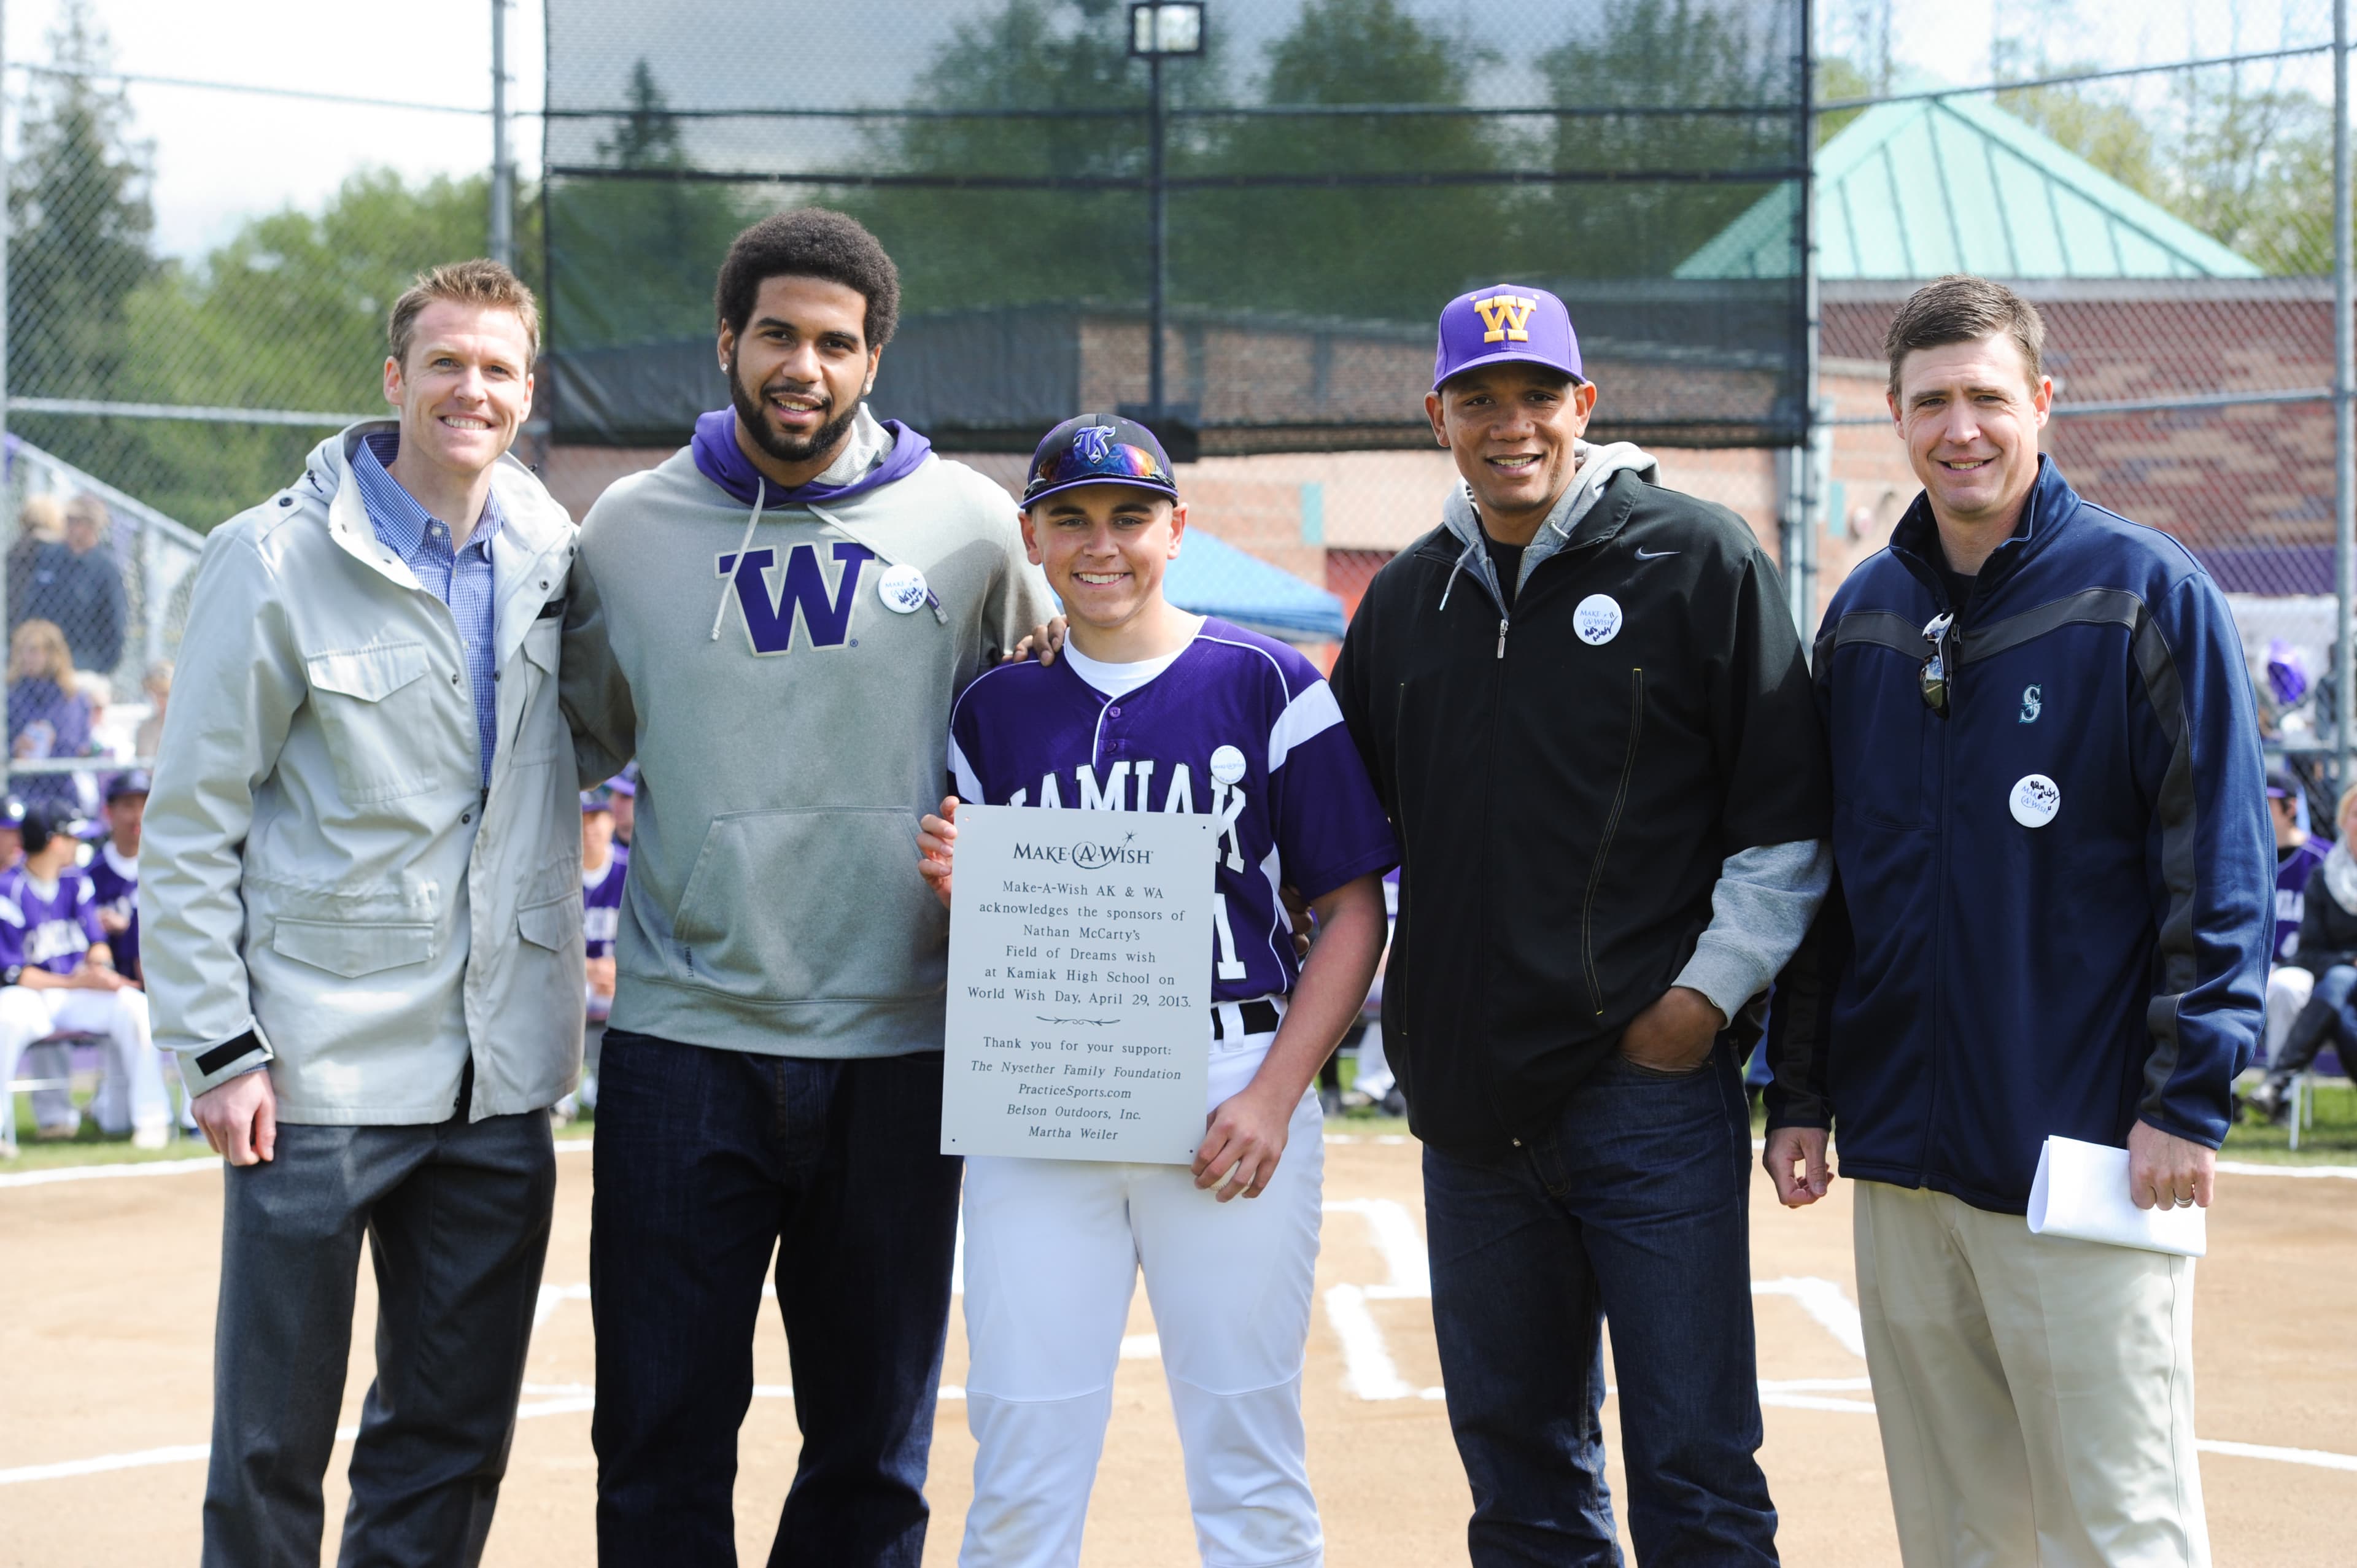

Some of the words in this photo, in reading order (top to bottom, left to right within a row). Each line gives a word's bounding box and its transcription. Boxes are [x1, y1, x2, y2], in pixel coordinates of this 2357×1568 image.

[1474, 295, 1537, 344] W
[1073, 425, 1116, 465] K
[714, 540, 879, 657] W
[1008, 760, 1247, 874] MIAK
[1003, 880, 1088, 895] Make-A-Wish
[1096, 885, 1116, 897] AK
[1124, 886, 1135, 898] &
[1144, 887, 1164, 899] WA
[979, 902, 1069, 917] acknowledges
[1078, 906, 1098, 917] the
[1107, 910, 1163, 921] sponsors
[1171, 910, 1186, 921] of
[1023, 924, 1070, 938] Nathan
[1079, 927, 1140, 943] McCarty's
[1006, 944, 1037, 957] Field
[1046, 947, 1061, 959] of
[1070, 948, 1117, 961] Dreams
[1126, 951, 1156, 963] wish
[985, 968, 997, 978] at
[1007, 967, 1056, 980] Kamiak
[1066, 969, 1098, 984] High
[1107, 971, 1150, 984] School
[1158, 976, 1175, 986] on
[967, 986, 1005, 999] World
[1013, 988, 1045, 1002] Wish
[1055, 990, 1081, 1005] Day,
[1088, 992, 1122, 1006] April
[1132, 994, 1150, 1007] 29,
[1158, 995, 1191, 1008] 2013.
[983, 1036, 1021, 1049] Thank
[1031, 1041, 1051, 1051] you
[1060, 1040, 1078, 1051] for
[1087, 1043, 1114, 1054] your
[1122, 1045, 1172, 1056] support:
[971, 1060, 993, 1072] The
[1001, 1061, 1056, 1075] Nysether
[1063, 1064, 1105, 1078] Family
[1113, 1066, 1181, 1080] Foundation
[1018, 1083, 1132, 1099] PracticeSports.com
[1006, 1103, 1047, 1116] Belson
[1055, 1106, 1112, 1120] Outdoors,
[1120, 1108, 1142, 1120] Inc.
[1028, 1126, 1072, 1138] Martha
[1080, 1127, 1118, 1140] Weiler
